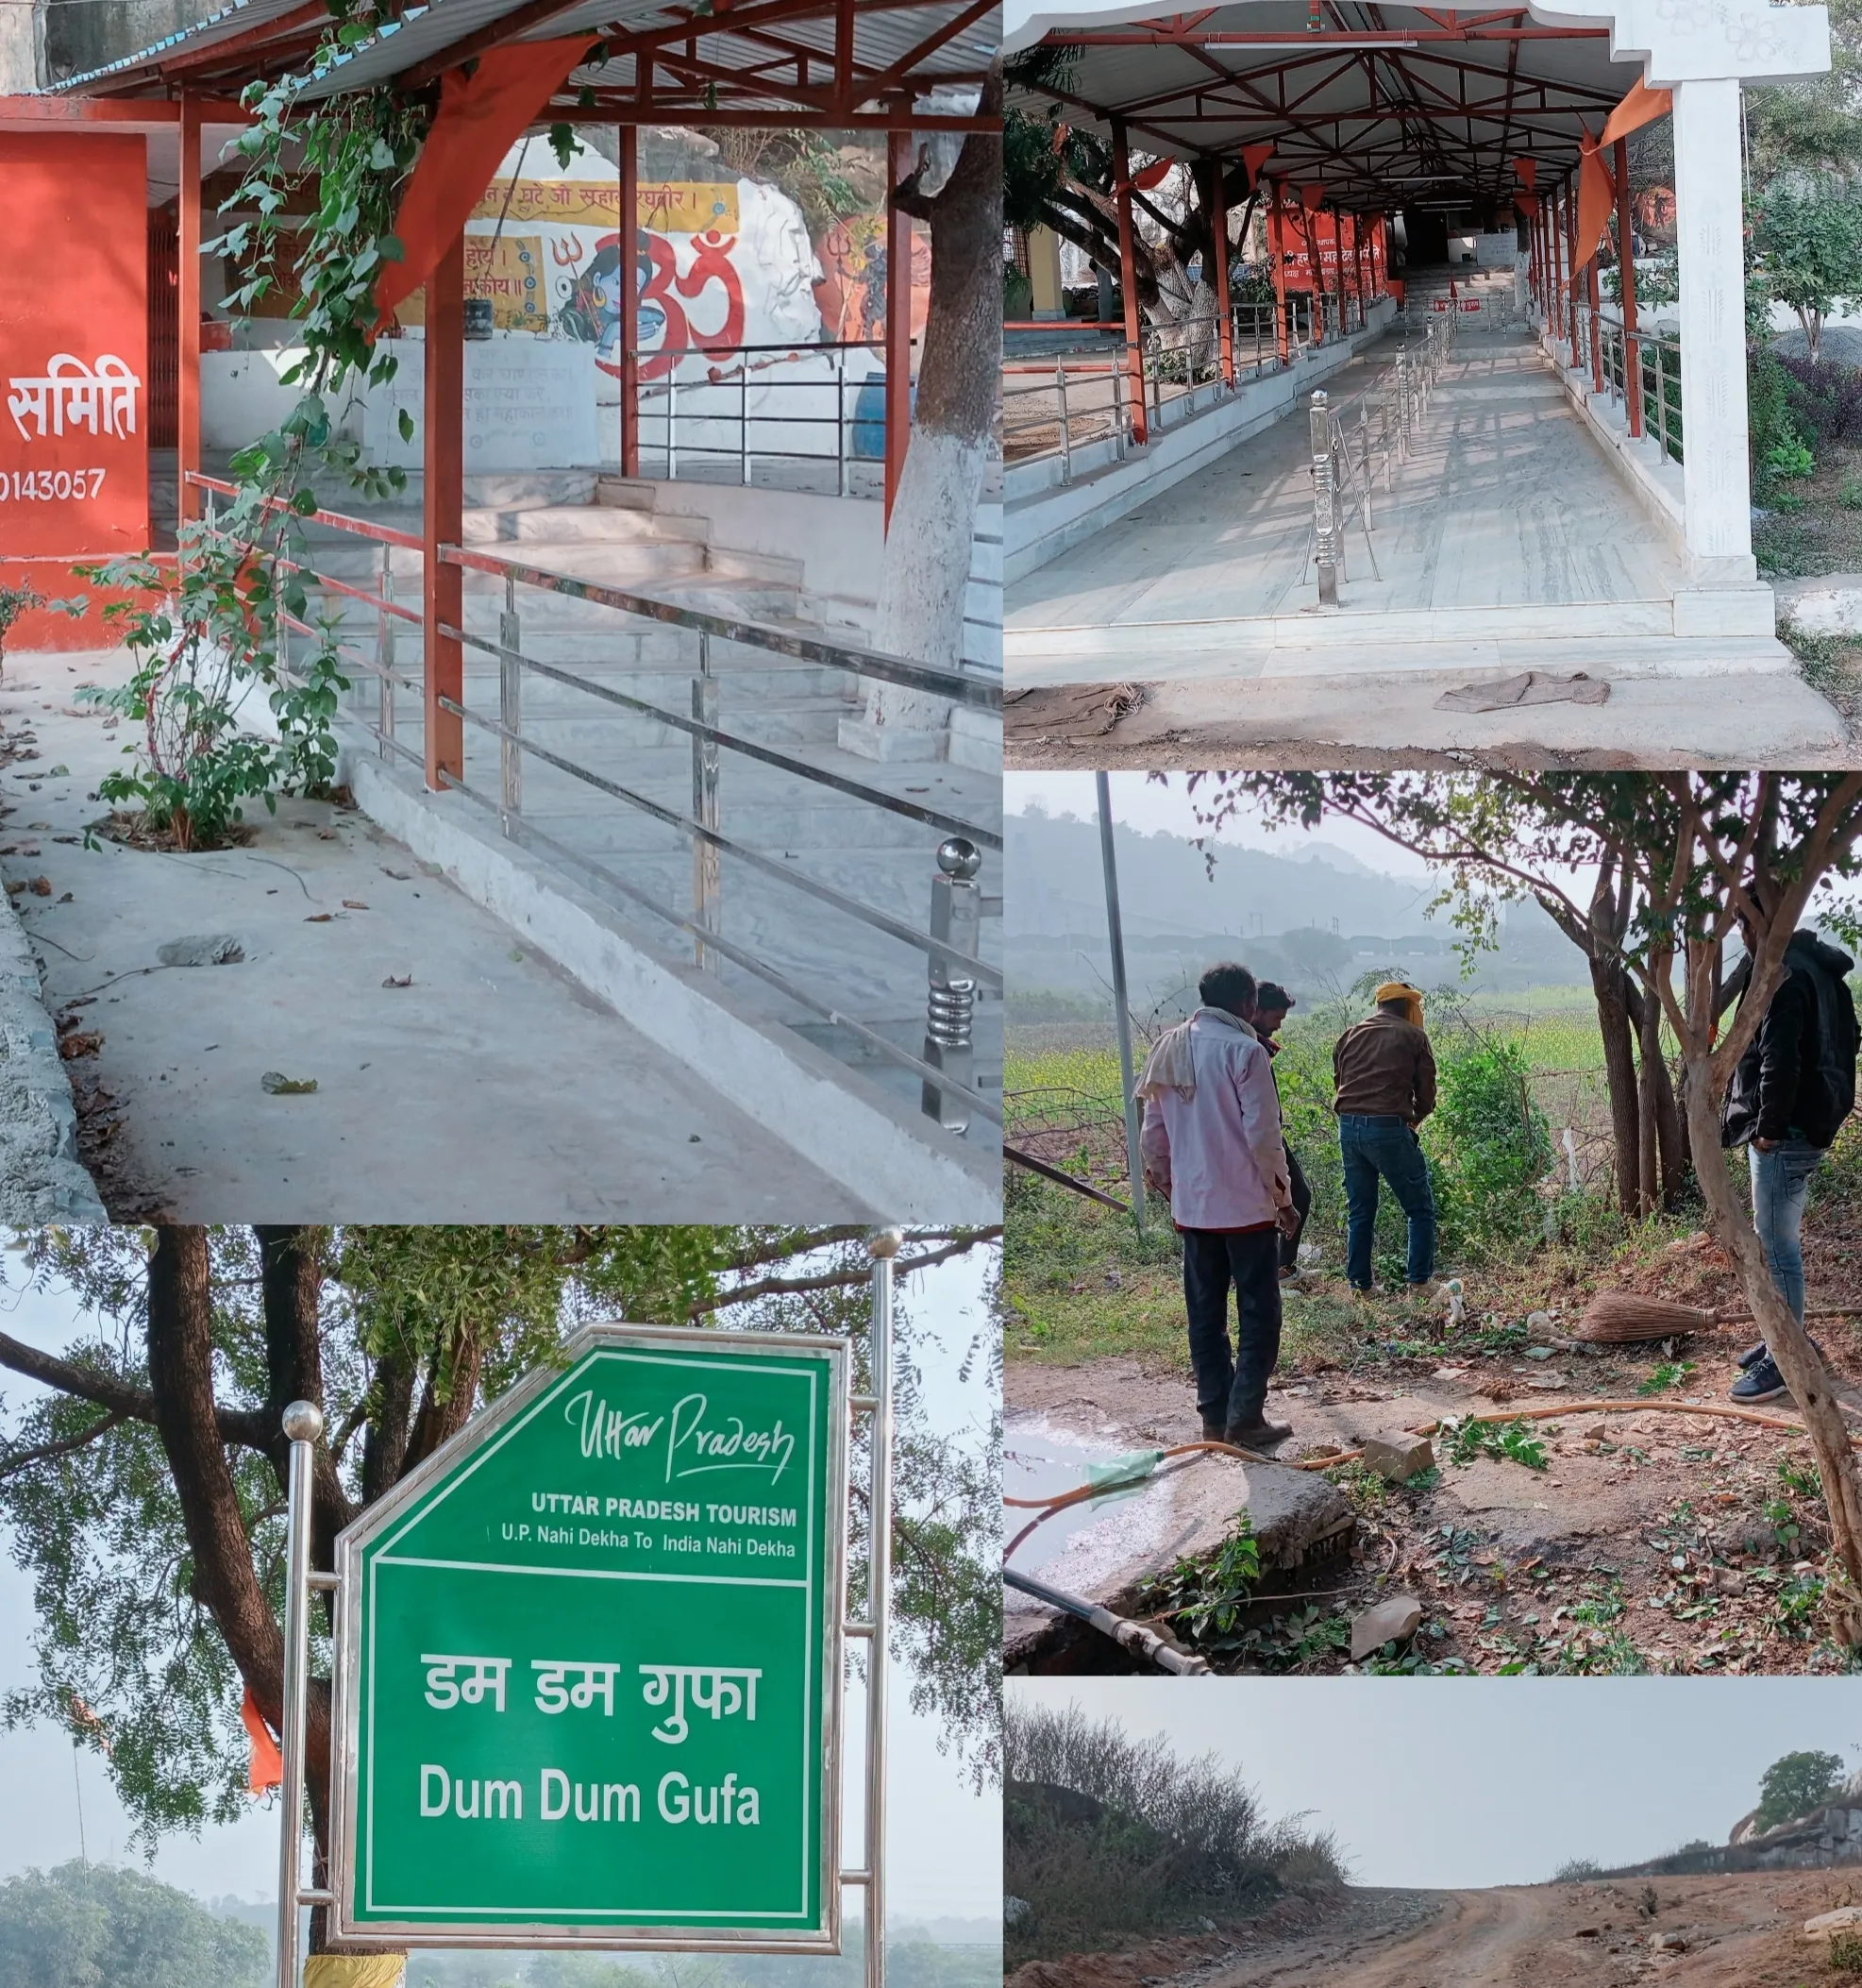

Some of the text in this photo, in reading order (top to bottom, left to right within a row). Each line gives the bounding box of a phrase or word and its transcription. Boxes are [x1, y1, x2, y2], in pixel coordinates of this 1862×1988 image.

[550, 182, 571, 206] जो
[8, 353, 142, 442] समिति
[564, 1390, 795, 1486] Uttar Pradesh
[501, 1523, 796, 1558] U.P. Nahi Dekha To India Nahi Dekha
[532, 1491, 797, 1527] UTTAR PRADESH TOURISM
[420, 1653, 763, 1744] डम डम गुफा
[420, 1763, 761, 1826] Dum Dum Gufa
